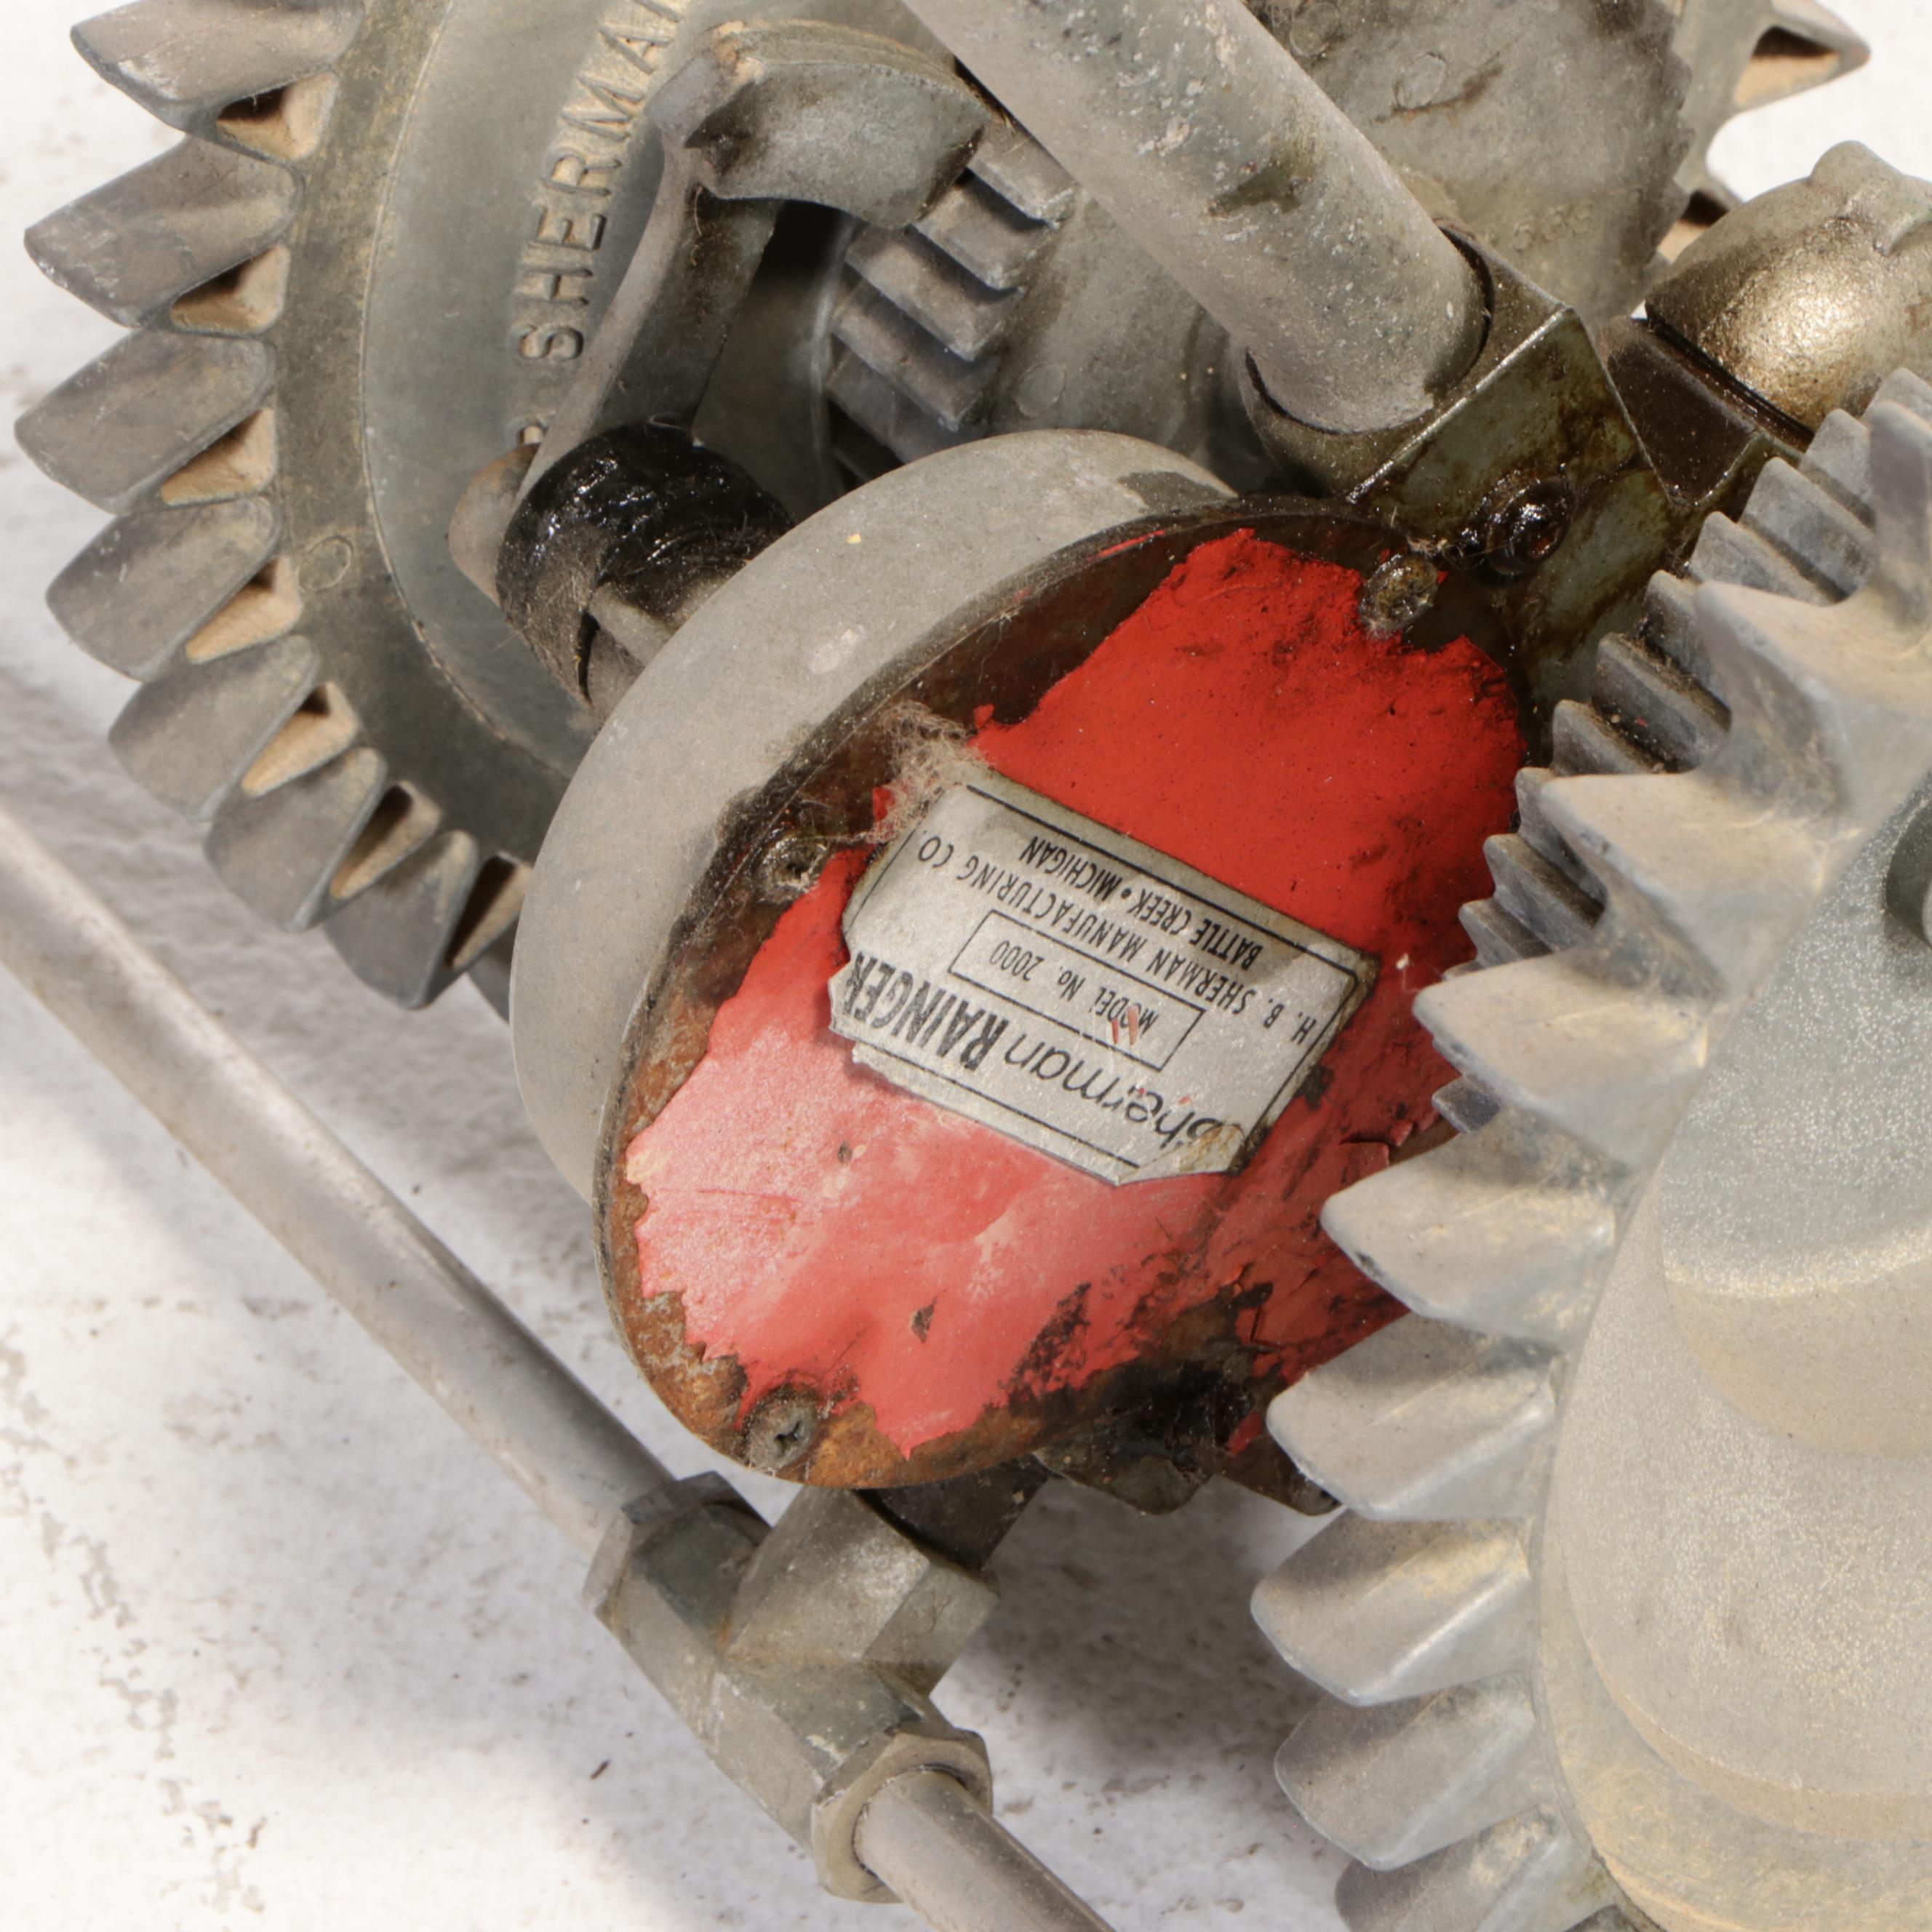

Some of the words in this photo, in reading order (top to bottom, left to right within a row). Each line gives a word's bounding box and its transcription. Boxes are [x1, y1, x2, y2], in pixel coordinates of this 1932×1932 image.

[917, 830, 954, 869] CO.
[1019, 836, 1122, 901] MICHIGAN
[956, 855, 1148, 962] MANUFACTURING
[1127, 888, 1191, 935] CREEK
[989, 940, 1045, 981] 2000
[1189, 918, 1264, 971] BATTLE
[1057, 966, 1086, 1002] No.
[1145, 948, 1257, 1015] SHERMAN
[1089, 986, 1159, 1035] MODEL
[1262, 998, 1285, 1029] B.
[1290, 1012, 1317, 1045] H.
